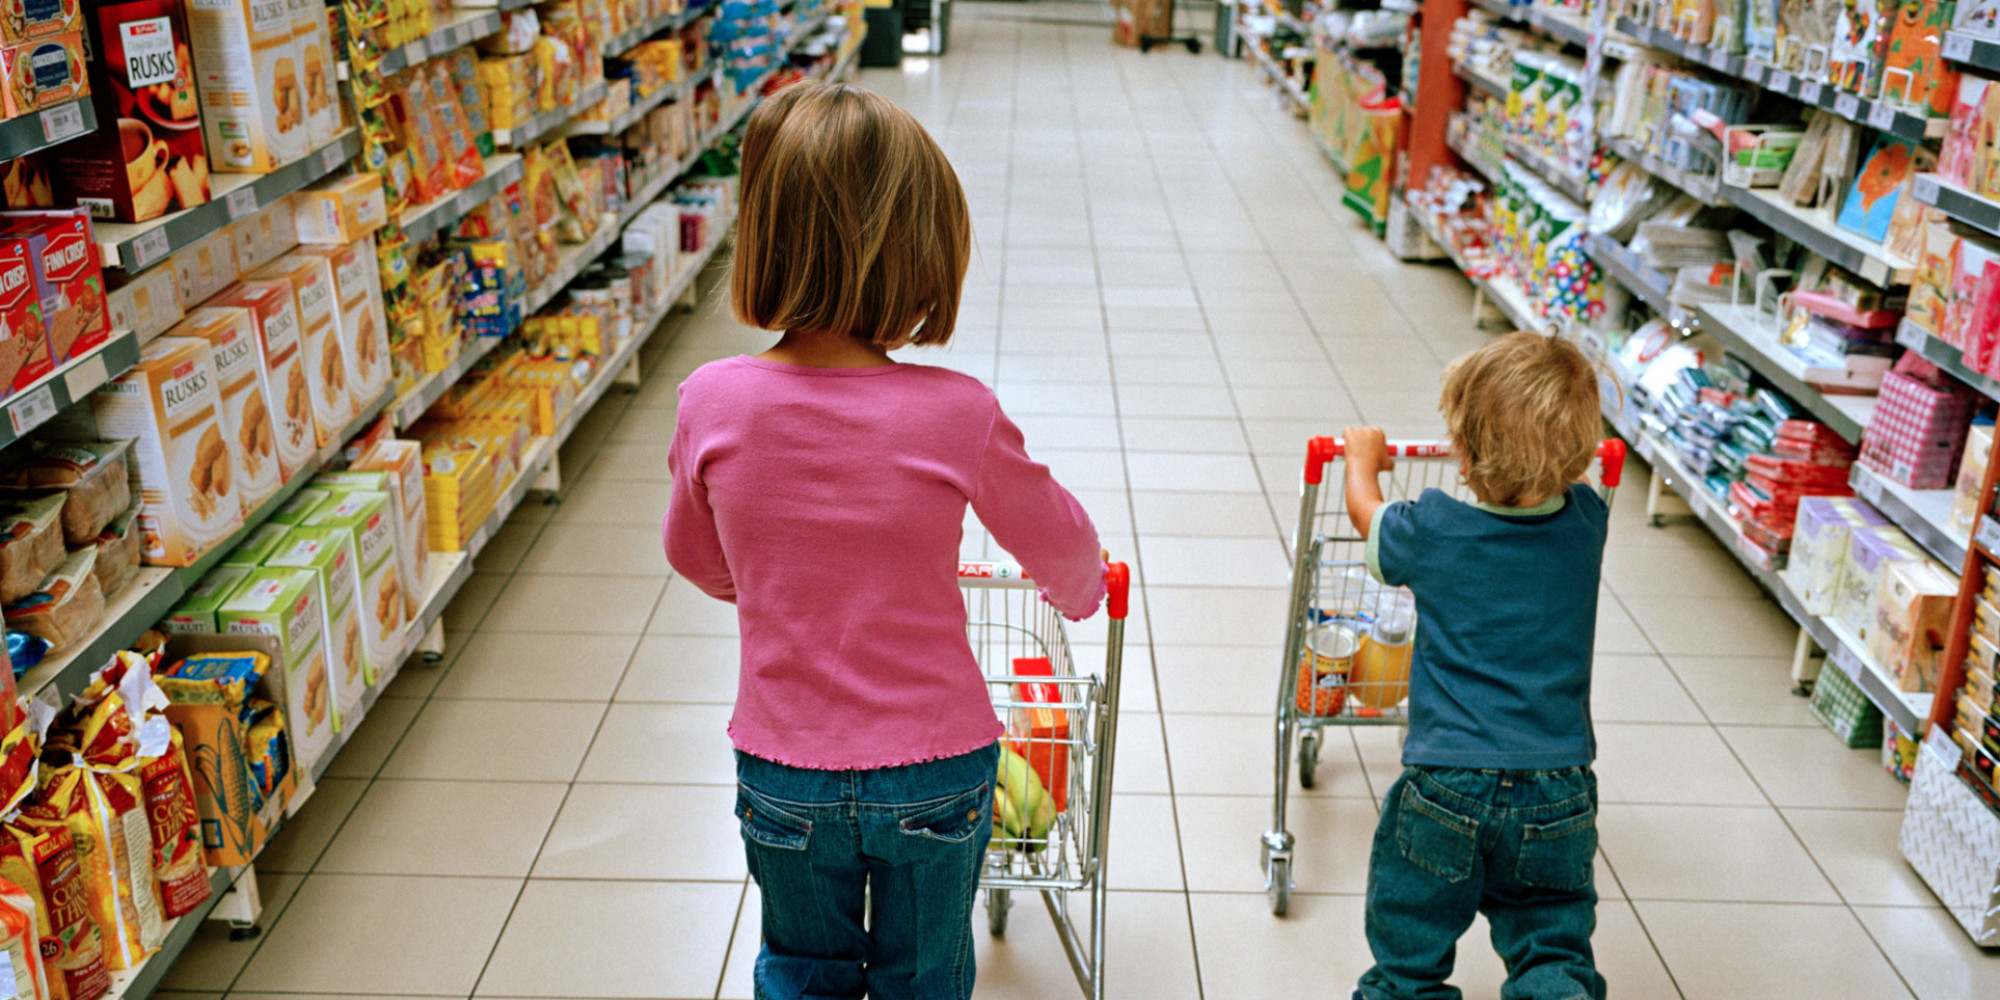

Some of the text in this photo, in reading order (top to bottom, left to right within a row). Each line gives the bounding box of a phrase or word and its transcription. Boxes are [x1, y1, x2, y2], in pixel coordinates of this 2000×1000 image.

[129, 51, 175, 80] RUSKS
[44, 239, 86, 274] FINN CRISP
[3, 265, 27, 291] CRISP
[214, 339, 249, 372] RUSKS
[165, 370, 208, 408] RUSKS
